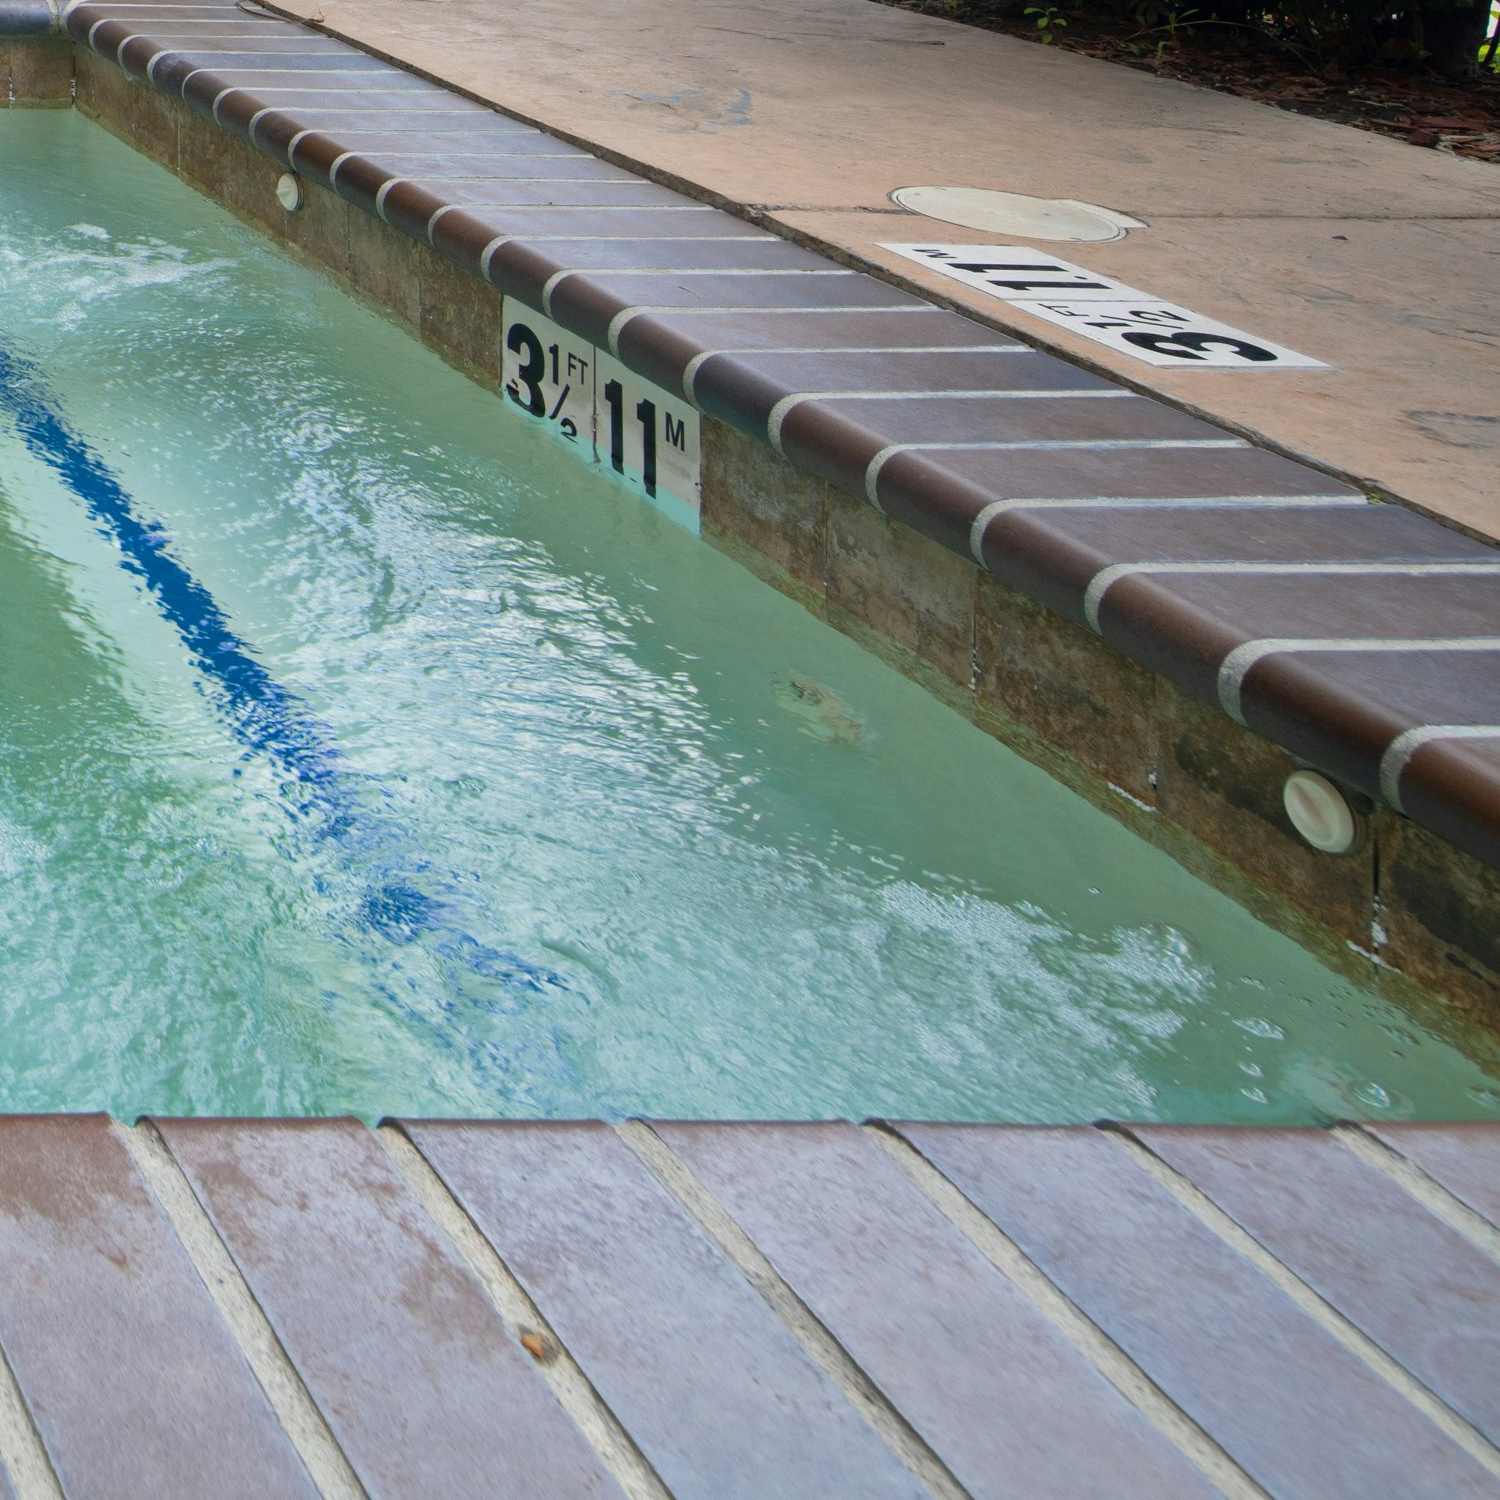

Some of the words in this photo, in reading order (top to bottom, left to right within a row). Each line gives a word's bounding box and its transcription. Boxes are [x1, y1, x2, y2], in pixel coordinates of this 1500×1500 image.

[911, 248, 958, 260] M
[567, 351, 589, 385] FT
[665, 411, 685, 452] M
